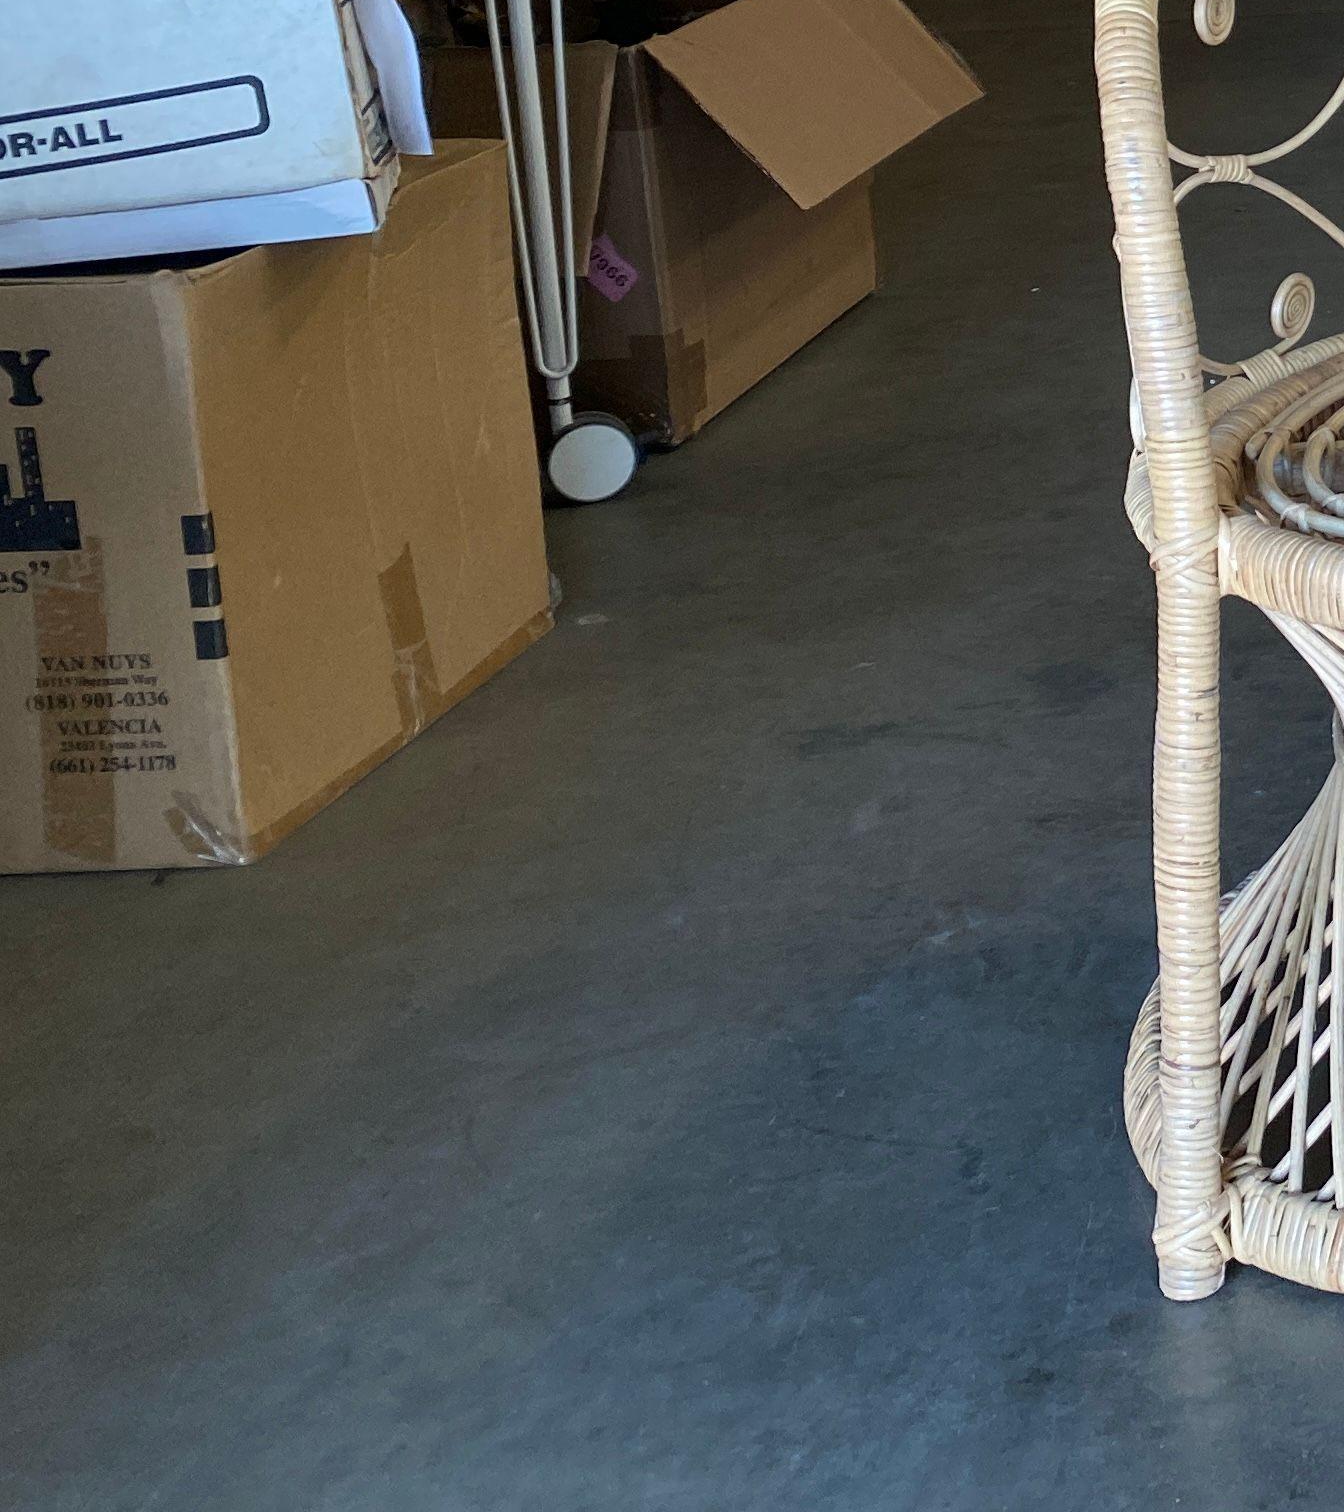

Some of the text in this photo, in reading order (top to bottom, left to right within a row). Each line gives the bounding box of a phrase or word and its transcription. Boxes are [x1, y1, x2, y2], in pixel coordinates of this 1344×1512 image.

[91, 653, 153, 670] NUYS
[81, 691, 169, 709] 901-0336
[57, 717, 162, 736] VALENCIA
